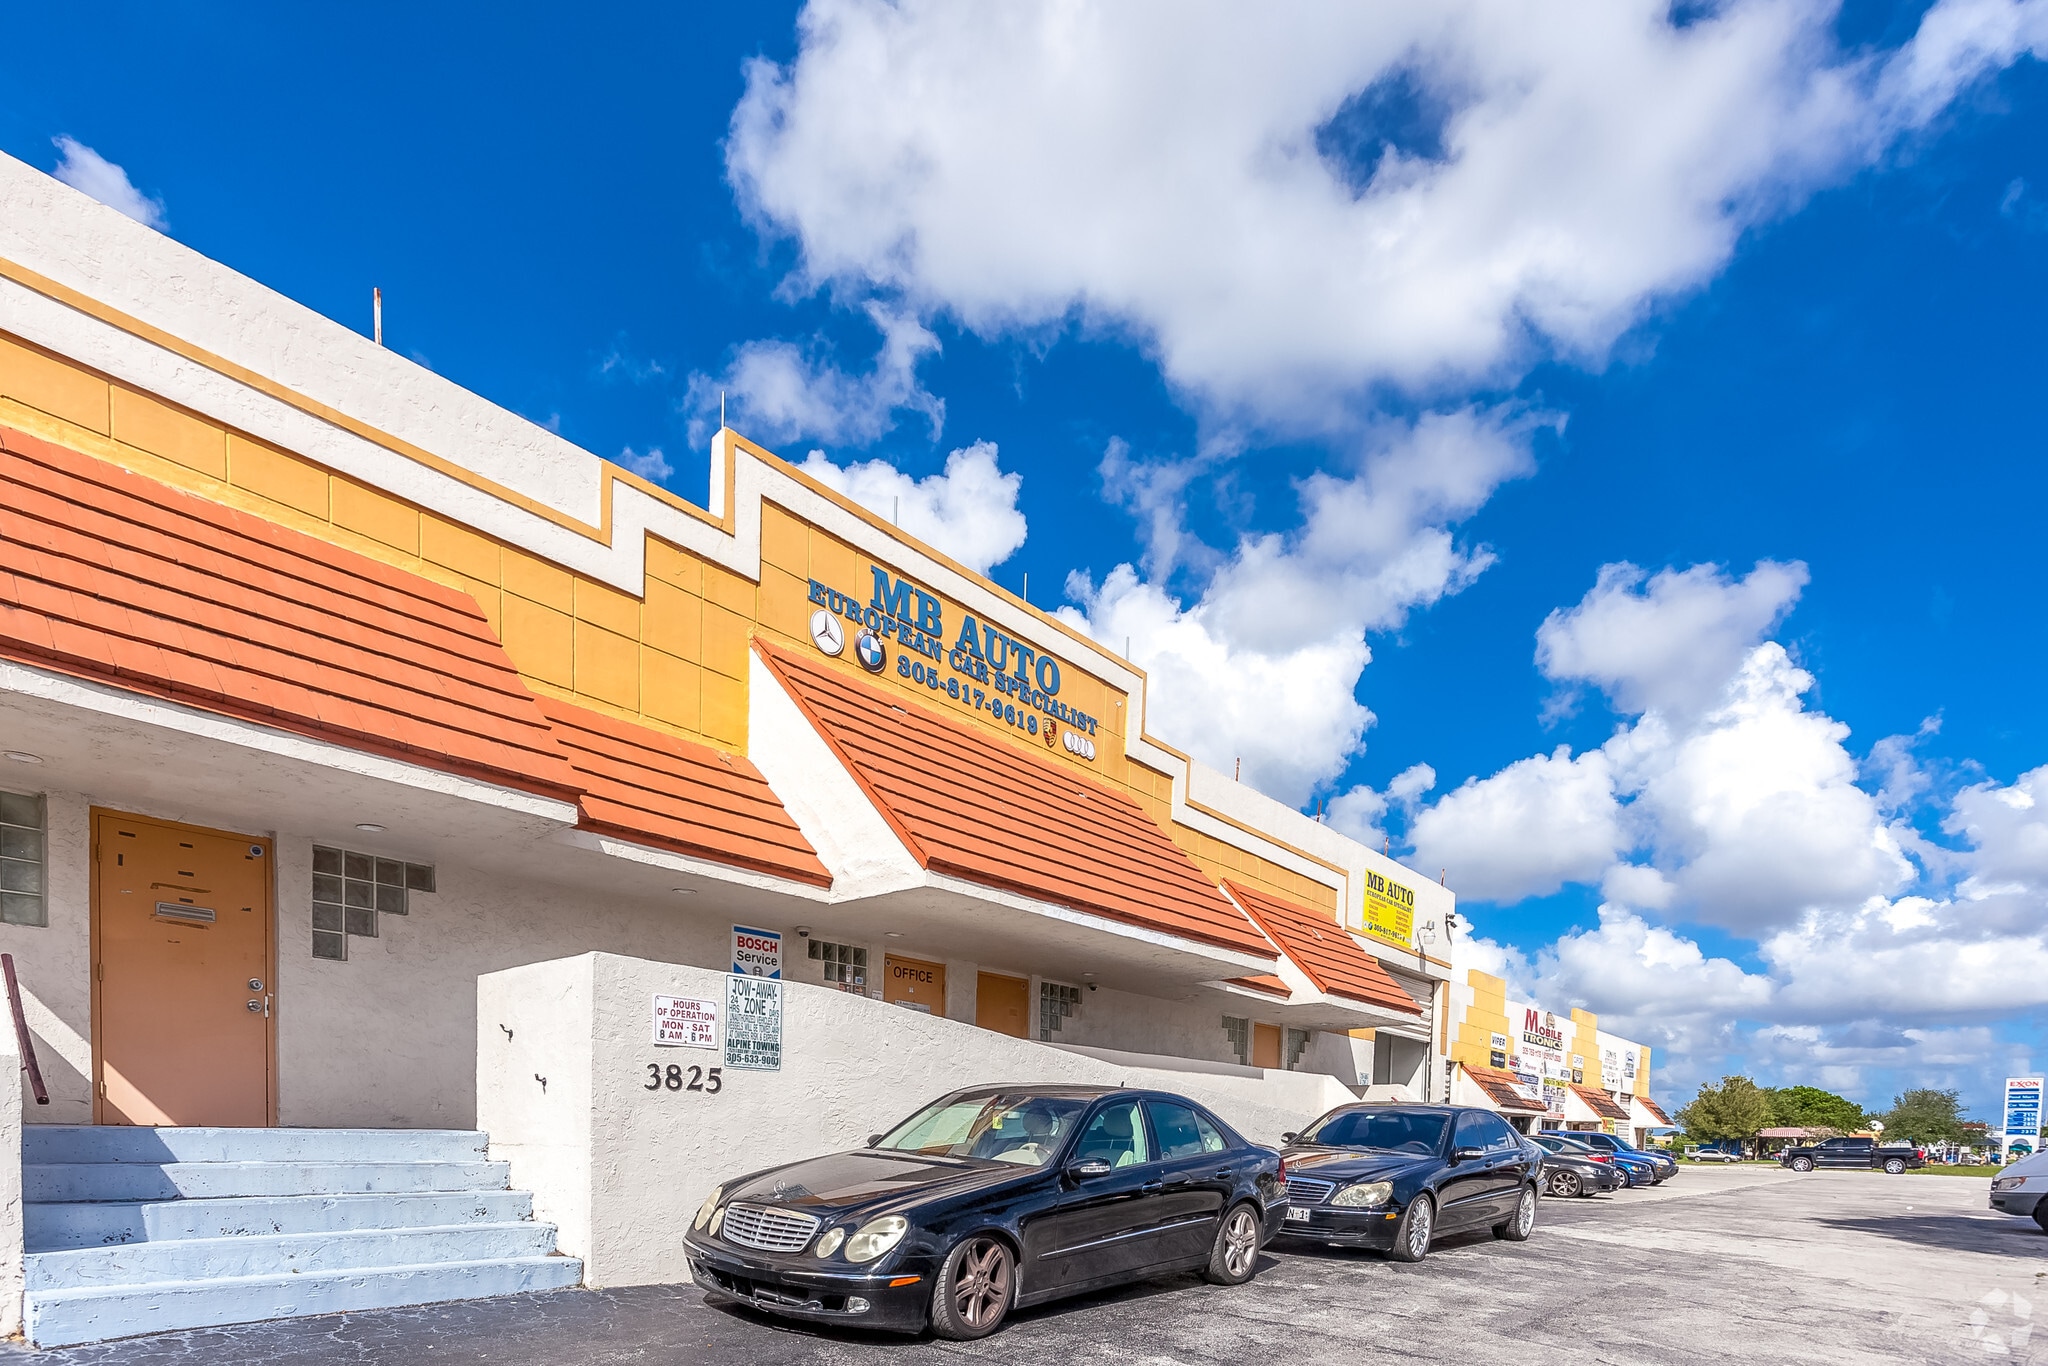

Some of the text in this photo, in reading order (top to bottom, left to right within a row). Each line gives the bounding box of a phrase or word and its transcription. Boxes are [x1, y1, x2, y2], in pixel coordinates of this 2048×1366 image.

[857, 627, 885, 647] BMW
[870, 565, 1061, 695] MB AUTO
[808, 578, 1098, 736] EUROPEAN CAR SPECIALIST
[897, 655, 1038, 735] 305-817-9619
[1367, 871, 1414, 906] MB AUTO
[737, 936, 777, 953] BOSCH
[737, 950, 777, 966] Service
[893, 966, 933, 984] OFFICE
[732, 979, 777, 999] TOW-AWAY
[673, 1000, 700, 1010] HOURS
[729, 1004, 779, 1017] HRS DAYS
[730, 995, 776, 1015] 24 ZONE 7
[657, 1008, 715, 1021] OF OPERATION
[662, 1021, 683, 1030] MON
[692, 1024, 710, 1032] SAT
[1525, 1008, 1562, 1041] MOBILE
[660, 1029, 665, 1039] 8
[668, 1031, 682, 1039] AM
[691, 1032, 696, 1041] 6
[699, 1034, 712, 1042] PM
[1524, 1032, 1562, 1050] TRONICS
[727, 1039, 751, 1049] ALPINE
[752, 1041, 779, 1052] TOWING
[727, 1053, 778, 1066] 305-633-9001
[644, 1063, 723, 1094] 3825
